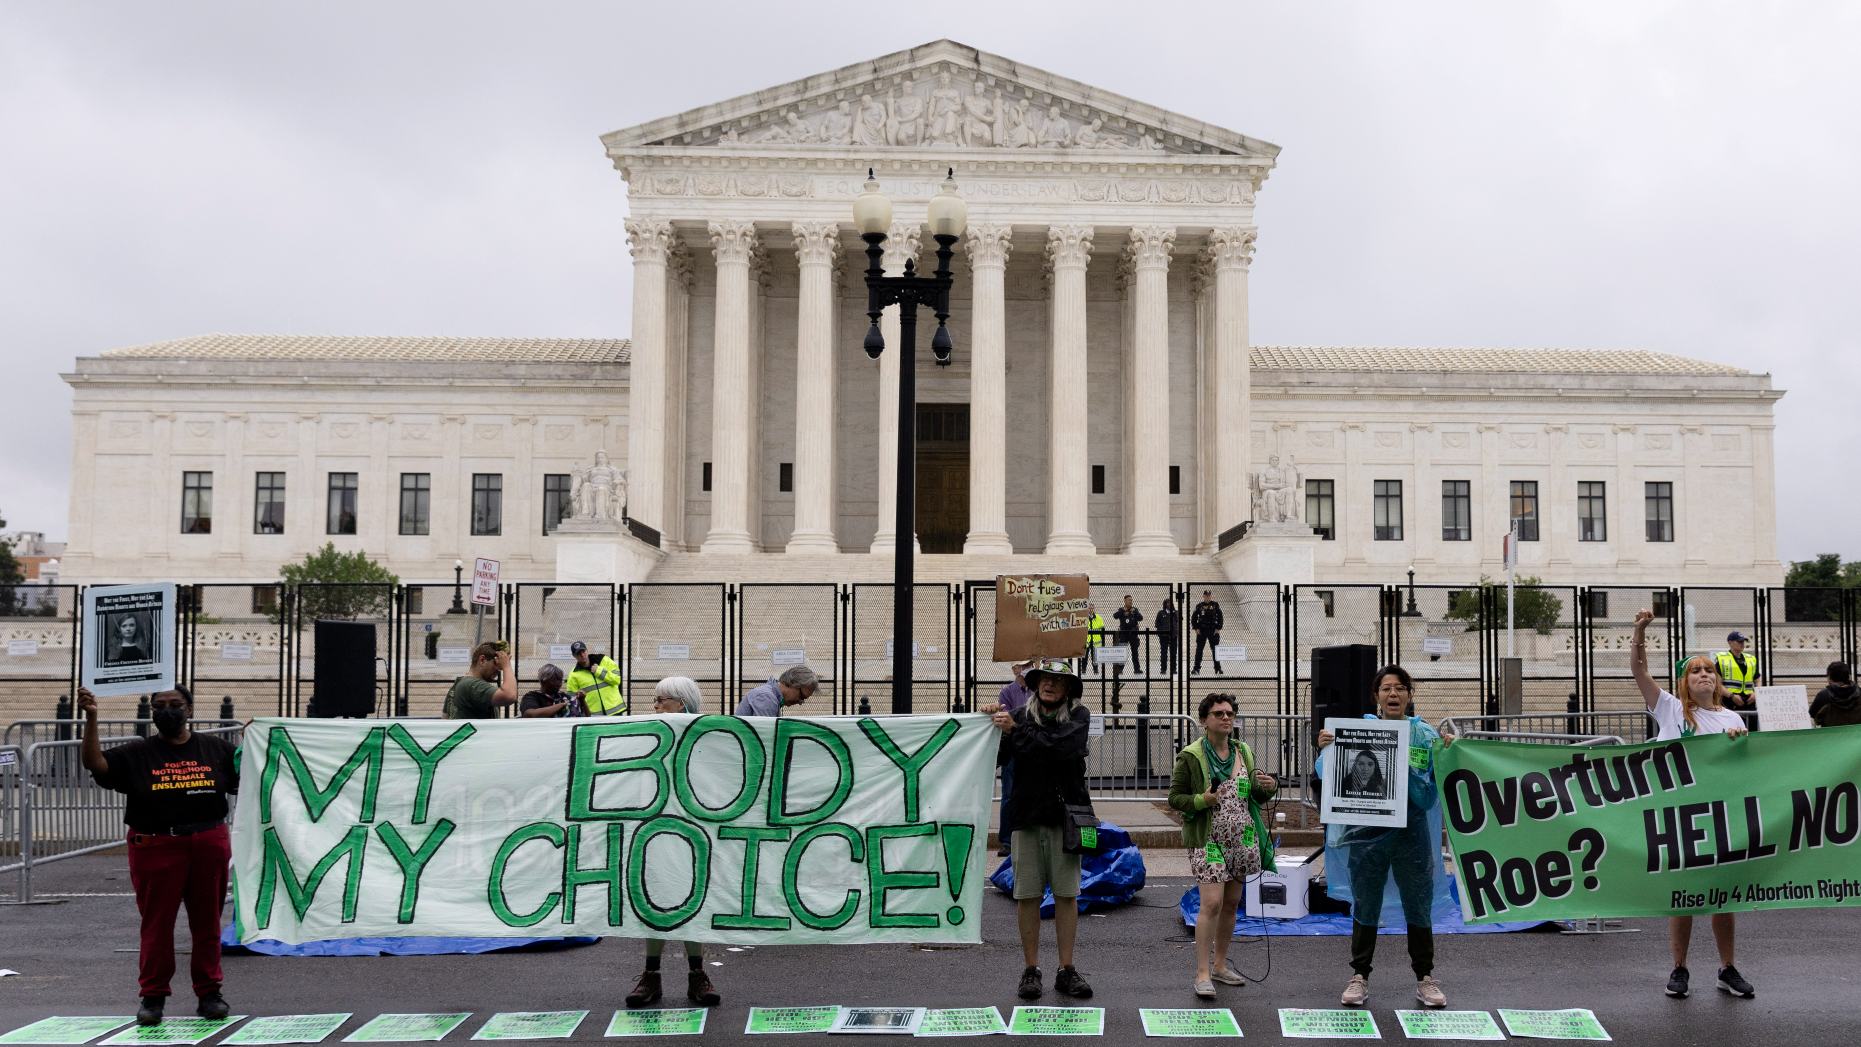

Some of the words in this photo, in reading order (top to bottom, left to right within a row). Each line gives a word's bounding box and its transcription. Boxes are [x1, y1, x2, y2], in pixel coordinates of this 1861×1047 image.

[965, 183, 1018, 196] UNDER
[1028, 184, 1061, 196] LAW
[483, 563, 492, 571] NO
[476, 570, 496, 581] PARKING
[1008, 581, 1034, 594] Don't
[1038, 580, 1060, 594] fuse
[1042, 619, 1060, 631] with
[152, 766, 212, 776] MOTHERHOOD
[260, 722, 476, 825] MY
[566, 716, 959, 826] BODY
[152, 780, 215, 790] ENSLAVEMENT
[1444, 742, 1696, 835] Overturn
[1644, 796, 1776, 873] HELL
[1789, 782, 1860, 851] NO
[256, 818, 456, 930] MY
[488, 815, 973, 931] CHOICE!
[1460, 827, 1606, 918] Roe?
[1672, 890, 1704, 908] Rise
[1709, 888, 1728, 908] Up
[1731, 886, 1741, 902] 4
[1746, 881, 1814, 903] Abortion
[1818, 879, 1861, 902] Right
